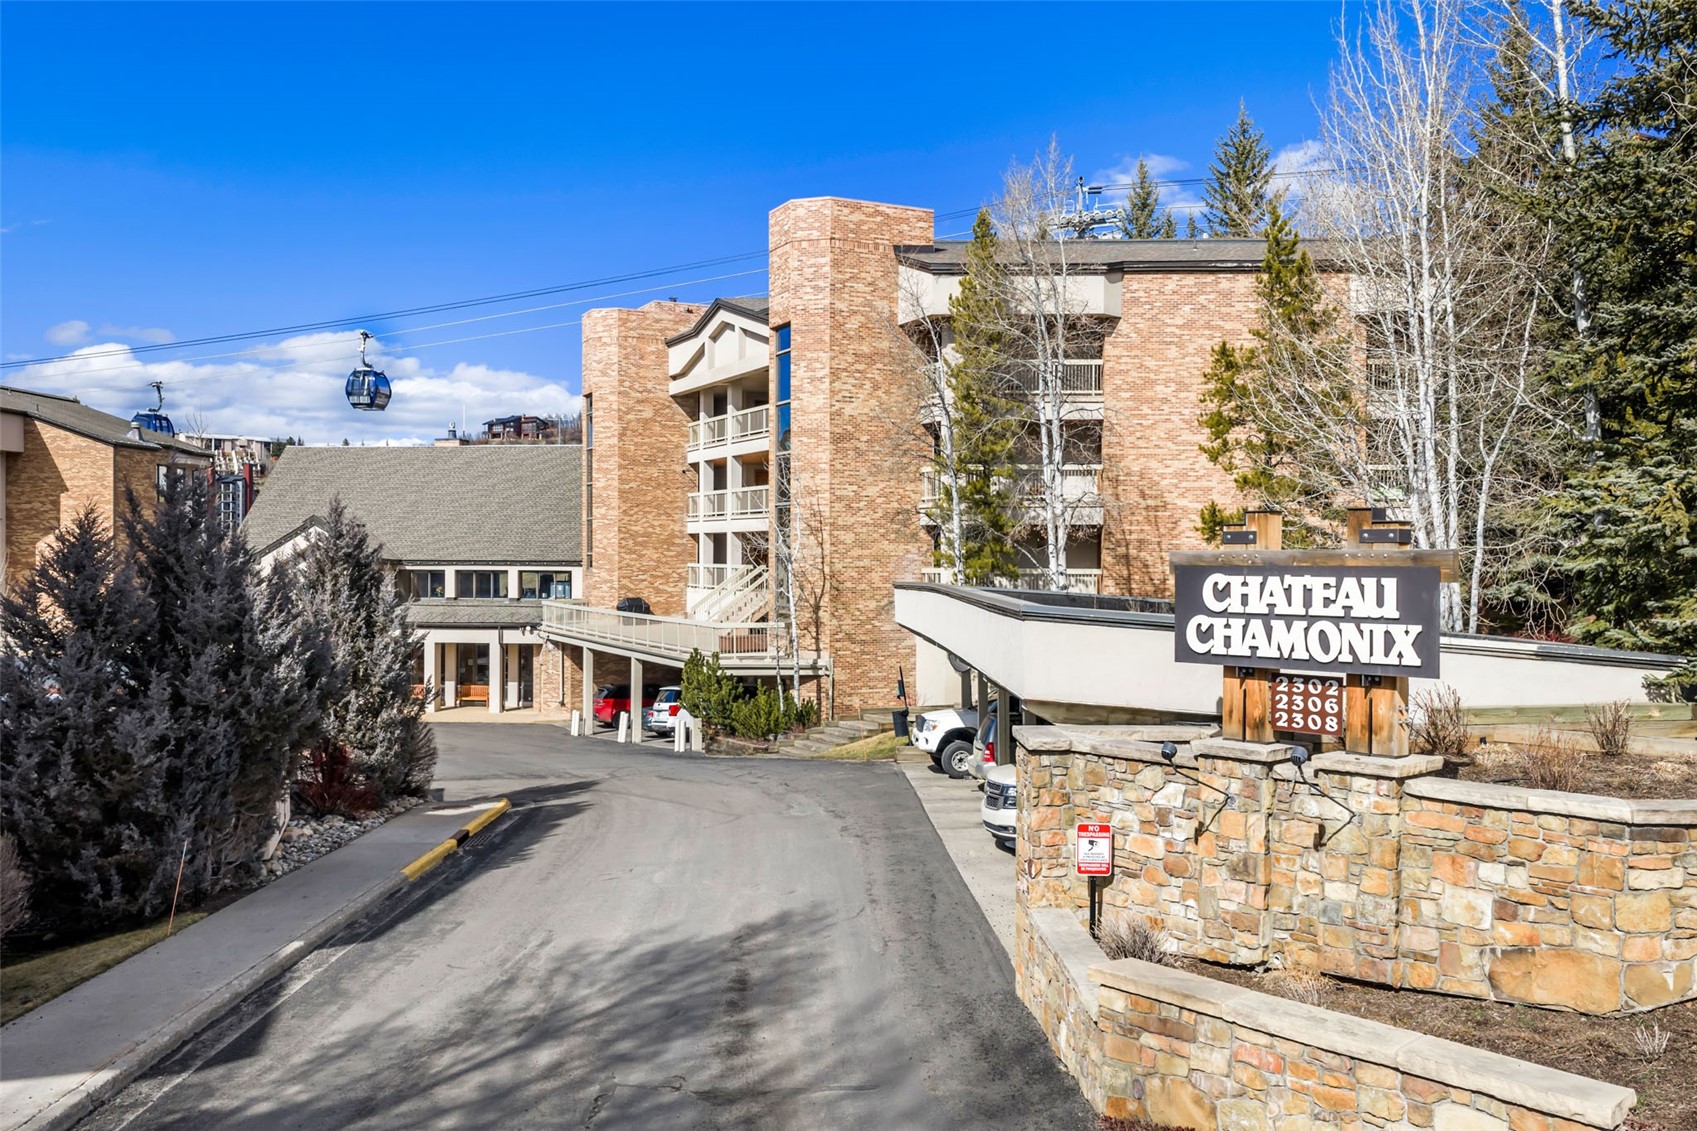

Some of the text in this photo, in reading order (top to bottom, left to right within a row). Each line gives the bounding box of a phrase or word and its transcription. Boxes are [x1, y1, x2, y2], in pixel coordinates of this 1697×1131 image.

[1202, 573, 1400, 619] CHATEAU
[1186, 614, 1422, 667] CHAMONIX
[1275, 676, 1339, 696] 2302
[1275, 693, 1339, 714] 2306
[1275, 711, 1338, 732] 2308
